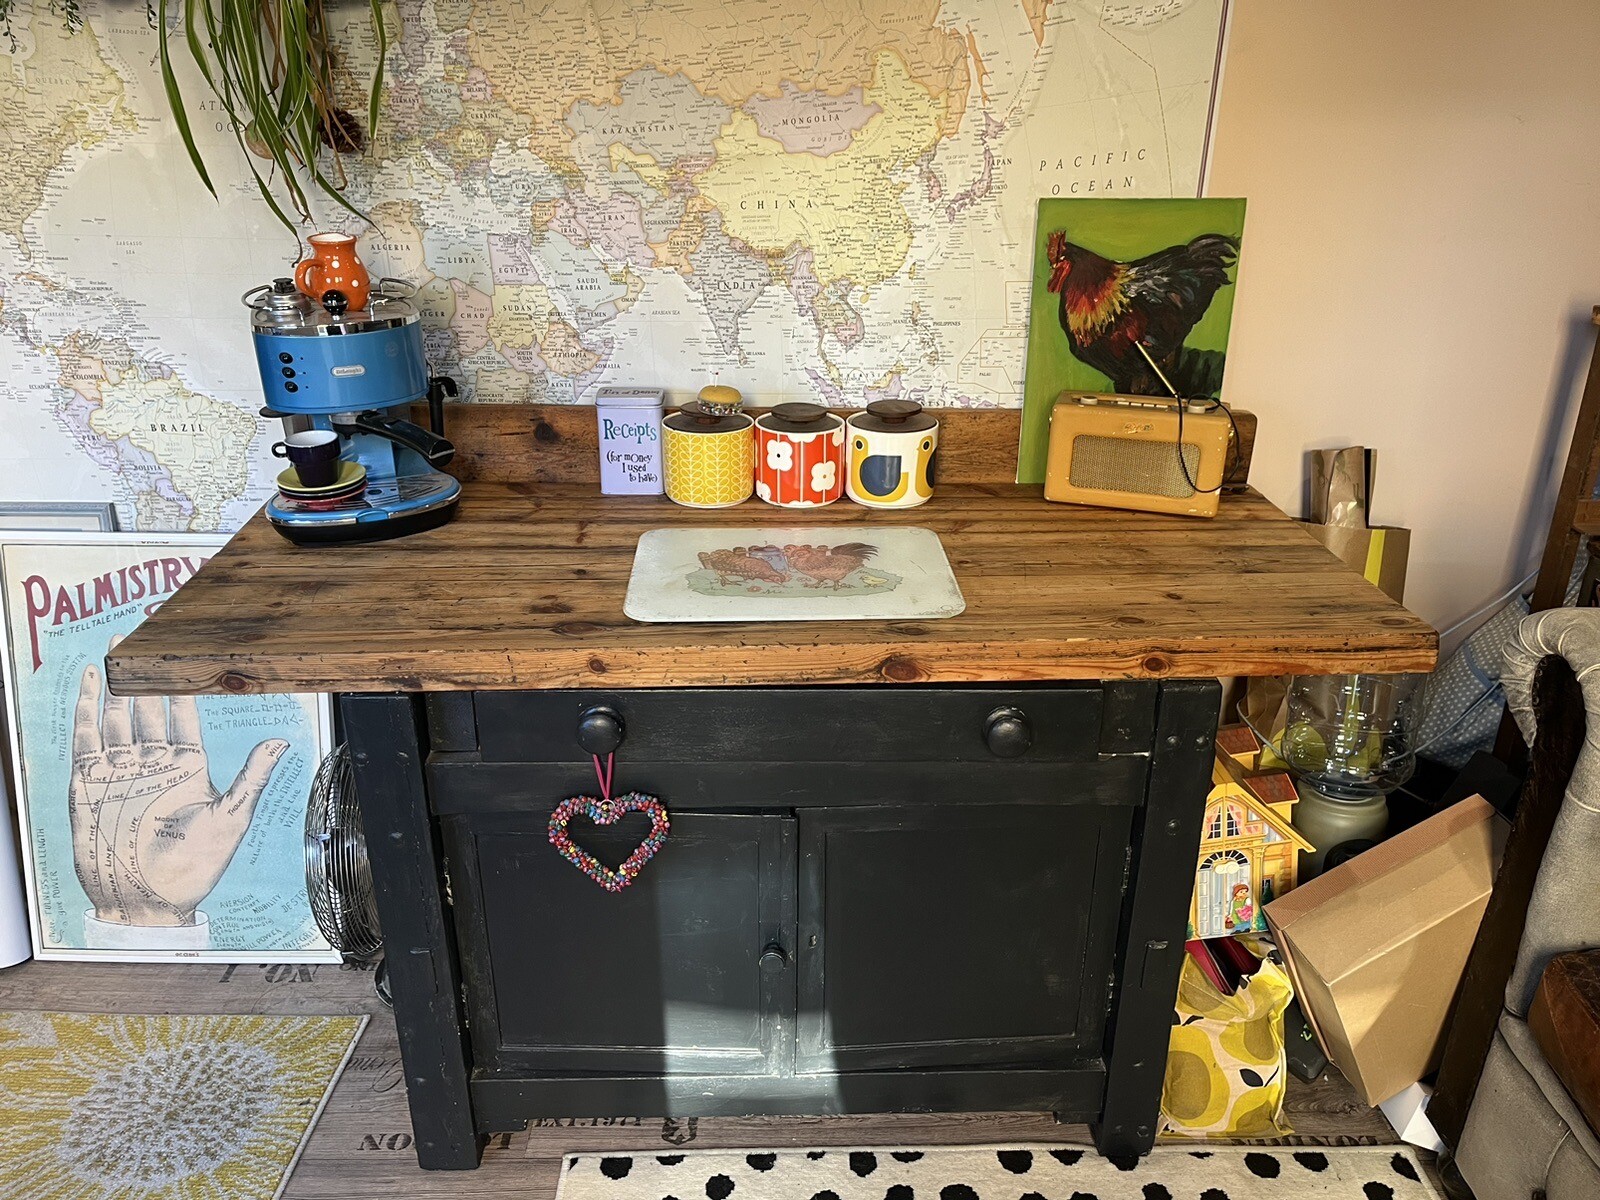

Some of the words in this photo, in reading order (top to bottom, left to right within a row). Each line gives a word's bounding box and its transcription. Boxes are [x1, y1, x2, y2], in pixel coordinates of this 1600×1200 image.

[781, 113, 840, 126] MONGOLIA
[602, 124, 675, 135] KAZAKHSTAN
[1039, 148, 1146, 172] PACIFIC
[1051, 175, 1134, 196] OCEAN
[740, 200, 813, 210] CHINA
[370, 243, 411, 252] ALGERIA
[447, 256, 476, 265] LIBYA
[716, 281, 756, 290] INDIA
[72, 373, 104, 381] COLOMBIA
[150, 423, 205, 433] BRAZIL
[602, 418, 657, 444] Receipts
[606, 449, 622, 464] (for
[624, 453, 653, 464] money
[134, 464, 162, 472] BOLIVIA
[622, 463, 626, 473] I
[627, 463, 647, 473] used
[629, 472, 637, 483] to
[638, 472, 658, 483] have)
[225, 716, 267, 728] TRIANGLE
[58, 723, 68, 761] INTELLECT
[268, 743, 283, 757] WILL
[147, 763, 174, 775] HEART
[283, 758, 305, 795] INTELLECT
[147, 783, 162, 792] THE
[88, 825, 97, 842] THE
[153, 829, 186, 841] VENUS
[36, 828, 47, 859] LENGTH
[129, 840, 135, 849] OF
[129, 856, 139, 874] LINE
[49, 870, 61, 899] POWER
[220, 892, 255, 910] AVERSION
[252, 893, 282, 914] MOBILITY
